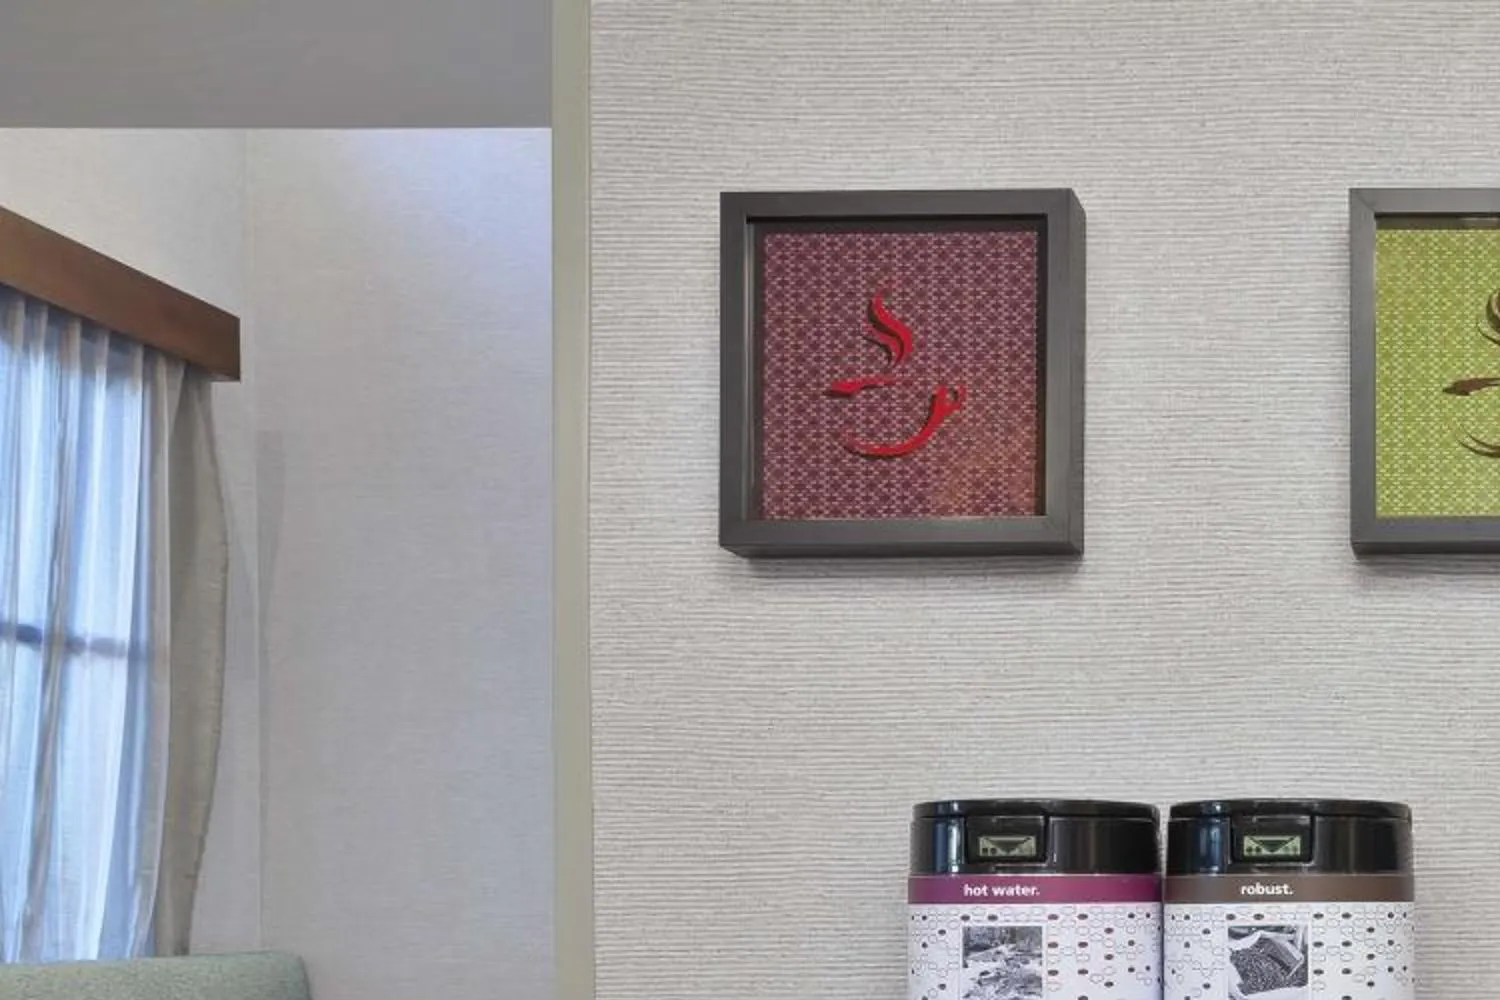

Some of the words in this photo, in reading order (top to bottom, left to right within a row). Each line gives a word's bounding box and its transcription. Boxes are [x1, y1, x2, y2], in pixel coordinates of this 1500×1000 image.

[963, 883, 988, 897] hot
[991, 884, 1041, 897] water.
[1241, 882, 1293, 895] robust.
